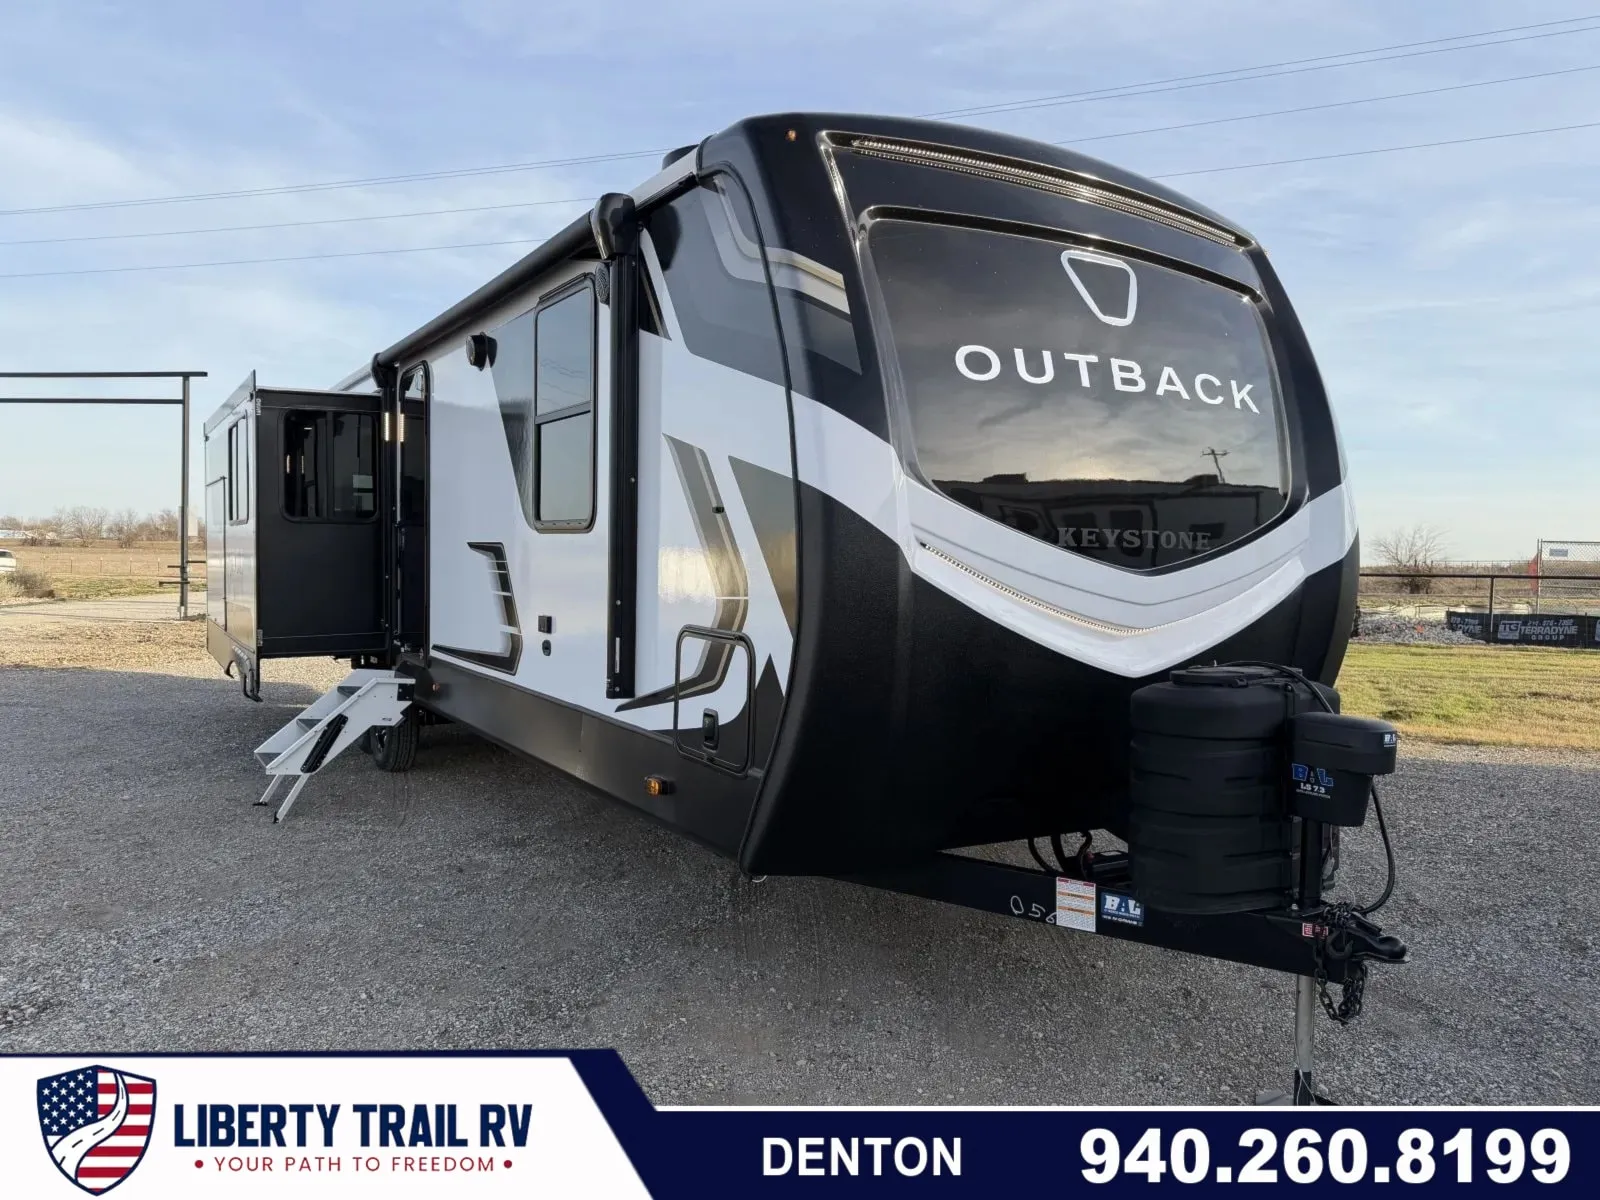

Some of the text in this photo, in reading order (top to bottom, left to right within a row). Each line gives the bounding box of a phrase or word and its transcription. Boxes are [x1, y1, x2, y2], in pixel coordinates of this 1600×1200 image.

[955, 344, 1261, 415] OUTBACK
[1057, 527, 1212, 550] KEYSTONE
[1520, 625, 1578, 635] TERRADYNE
